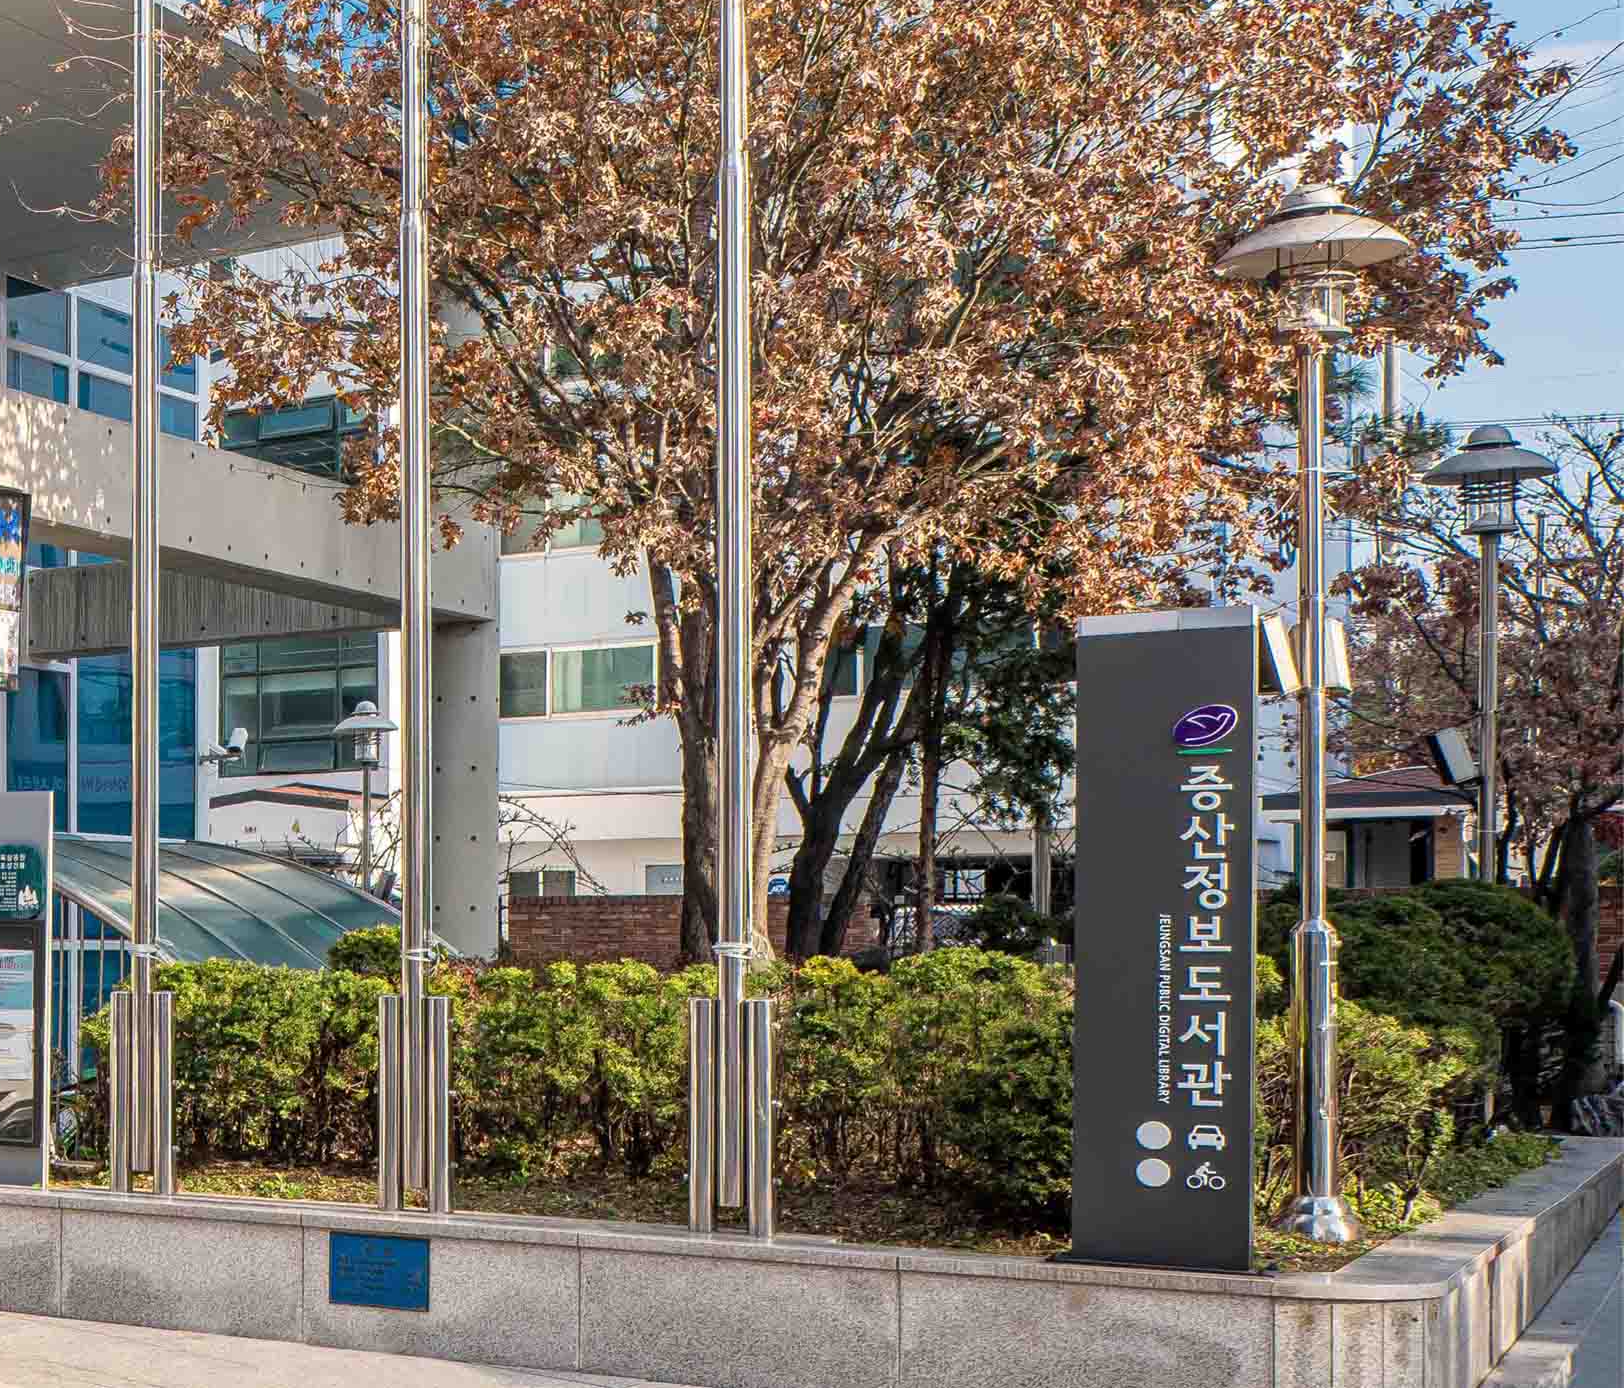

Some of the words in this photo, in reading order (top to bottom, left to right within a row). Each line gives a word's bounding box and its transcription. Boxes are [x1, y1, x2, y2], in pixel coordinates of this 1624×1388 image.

[1159, 914, 1172, 972] JEUNGSAN
[1177, 764, 1235, 1108] 증산정보도서관
[1158, 974, 1171, 1012] PUBLIC
[1158, 1015, 1170, 1057] DIGITAL
[1157, 1059, 1170, 1105] LIBRARY
